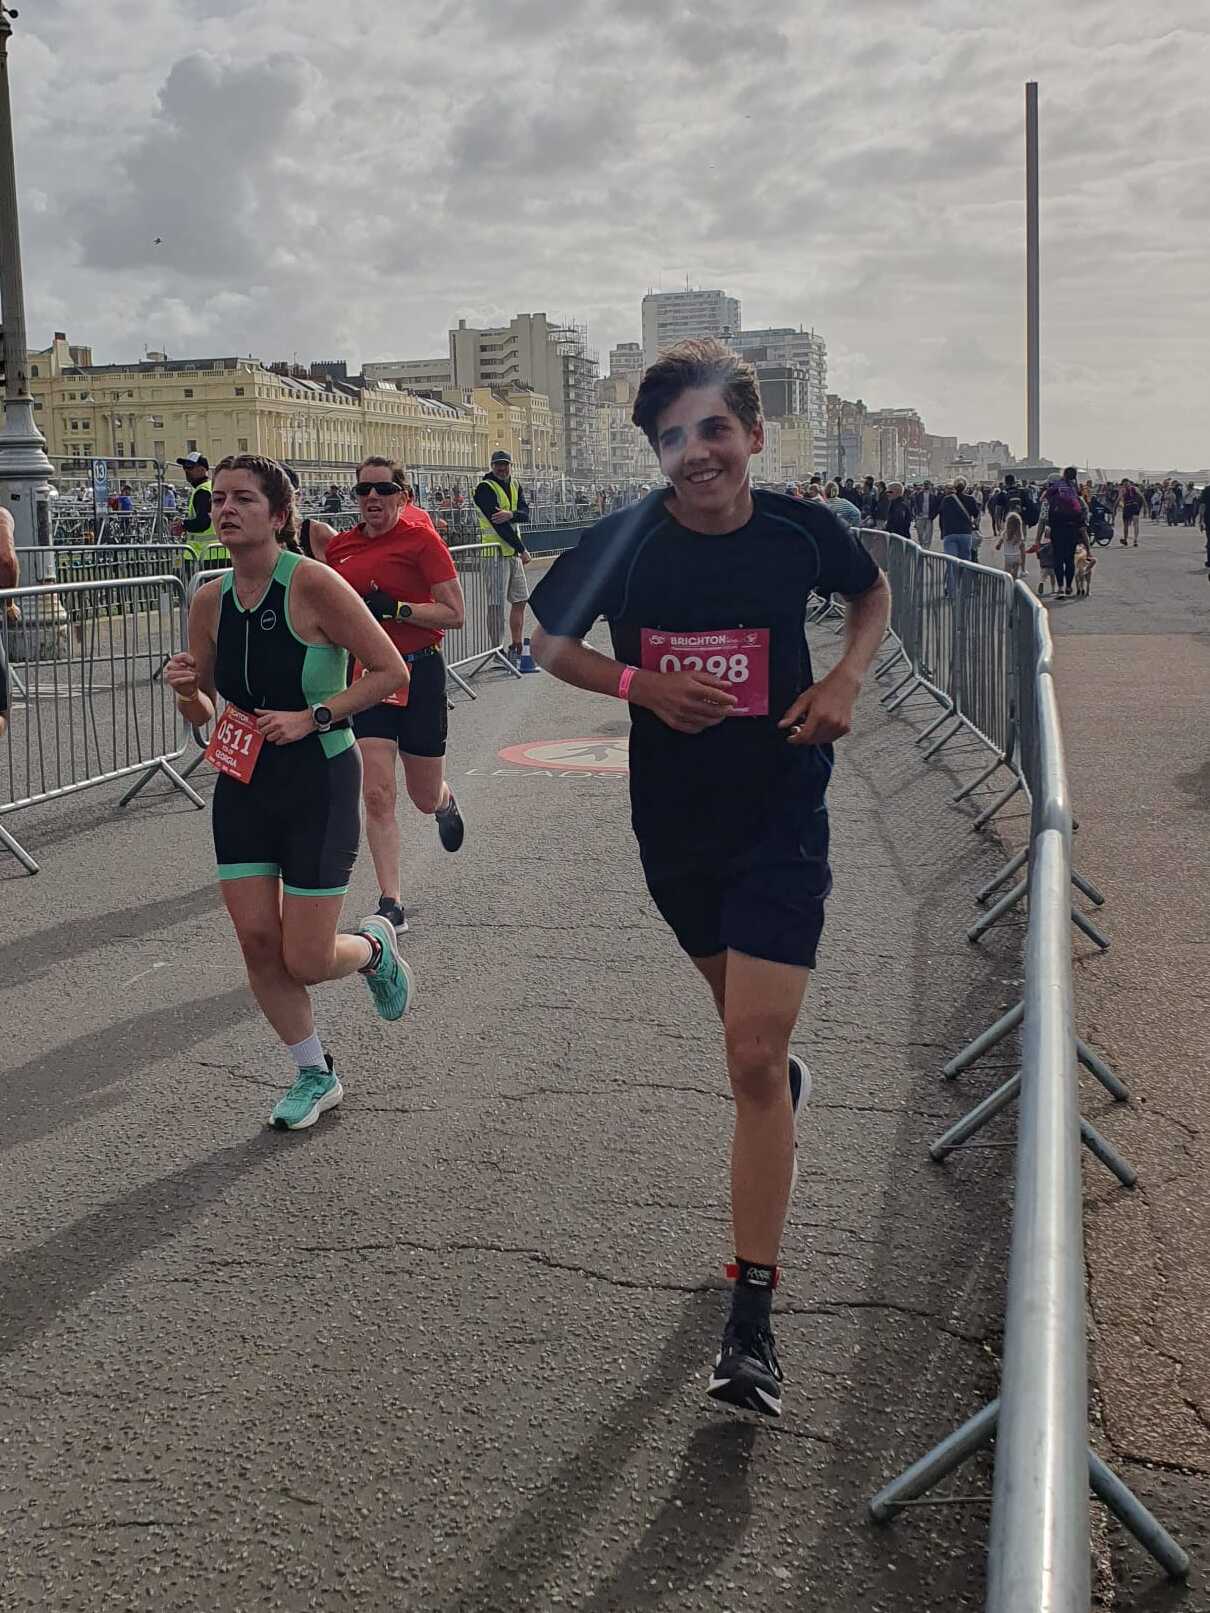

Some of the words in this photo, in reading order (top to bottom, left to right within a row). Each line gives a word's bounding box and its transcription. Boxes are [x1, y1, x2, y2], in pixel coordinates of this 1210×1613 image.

[96, 464, 104, 478] 13
[670, 635, 726, 646] BRIGHTON
[217, 720, 252, 755] 0511
[464, 768, 625, 778] LEADS
